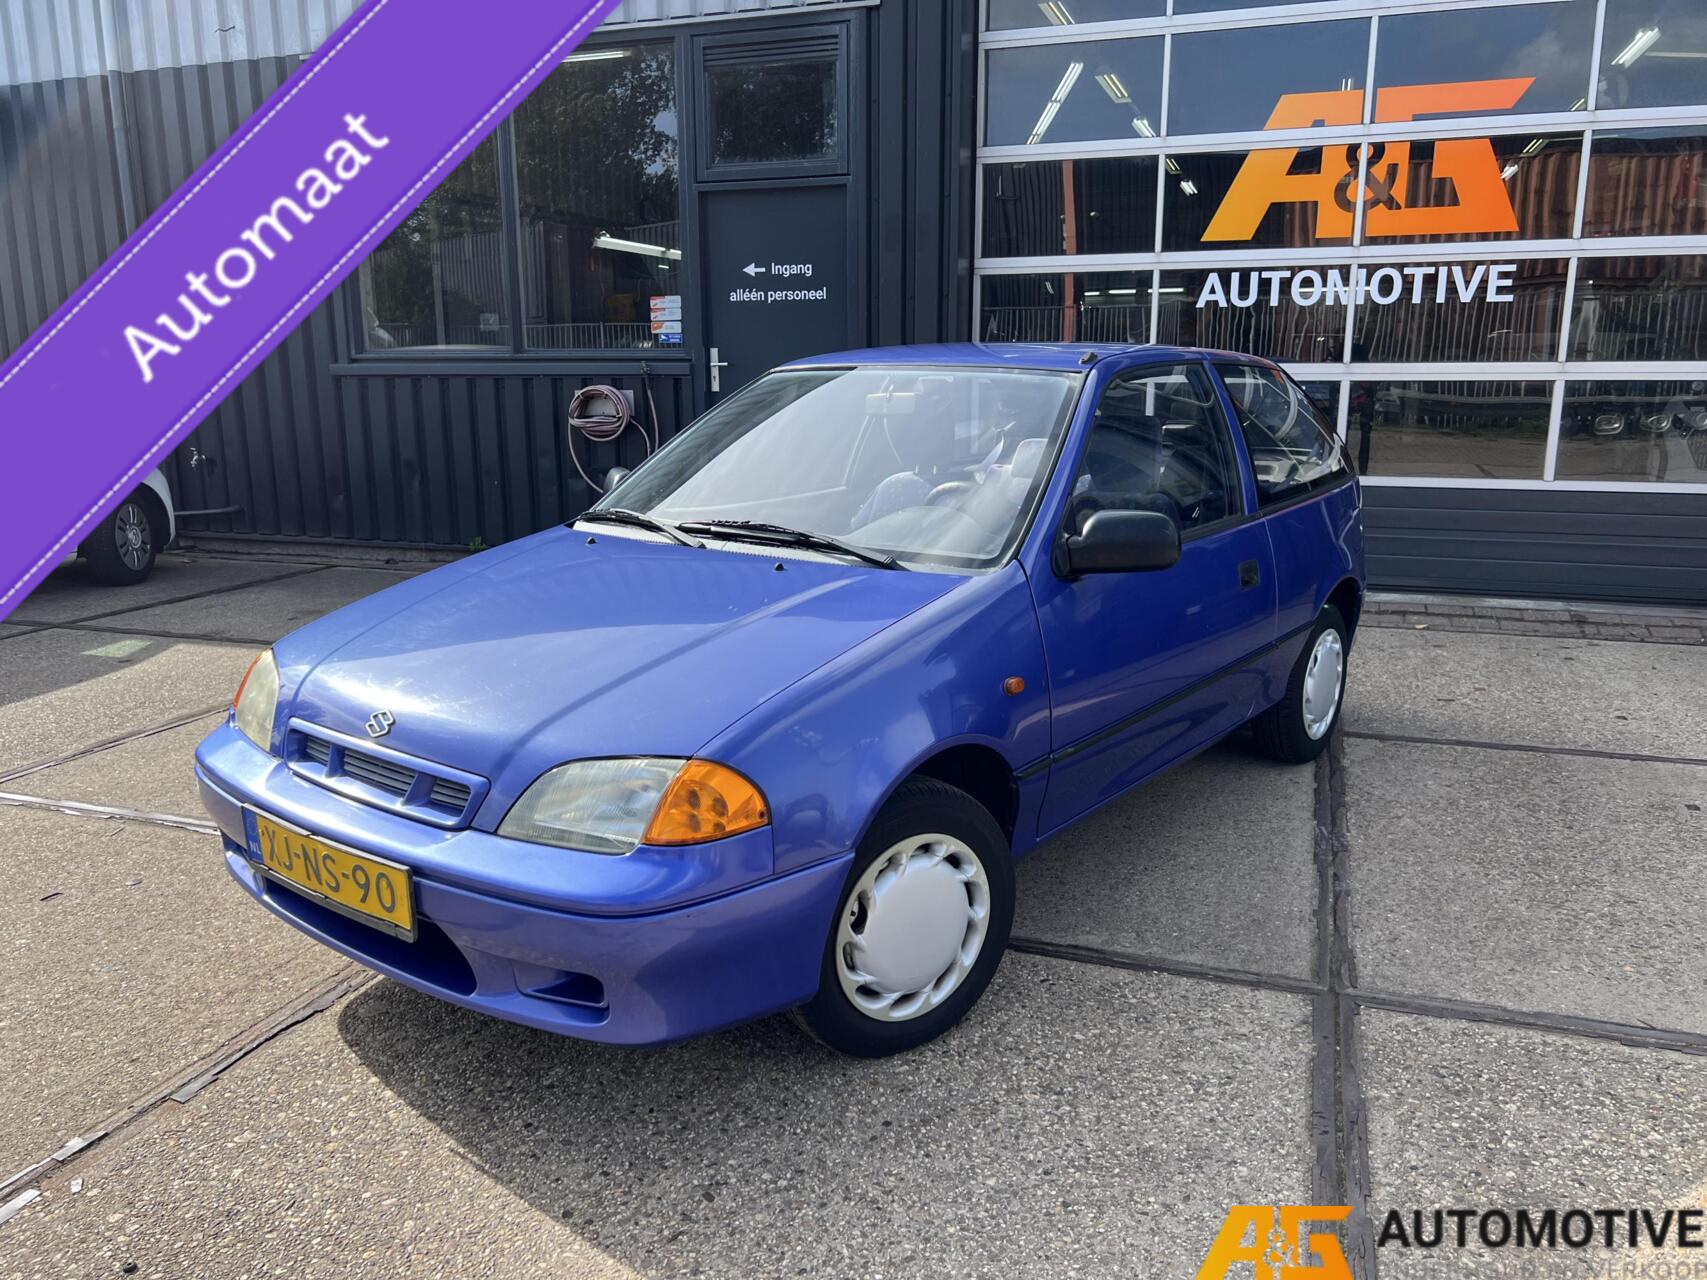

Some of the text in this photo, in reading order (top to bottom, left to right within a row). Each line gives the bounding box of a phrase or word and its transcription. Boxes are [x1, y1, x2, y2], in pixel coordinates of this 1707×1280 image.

[1201, 77, 1536, 242] A&G
[771, 262, 813, 277] Ingang
[1196, 264, 1517, 308] AUTOMOTIVE
[729, 287, 827, 303] alléén personeel
[263, 824, 397, 914] XJ-NS-90
